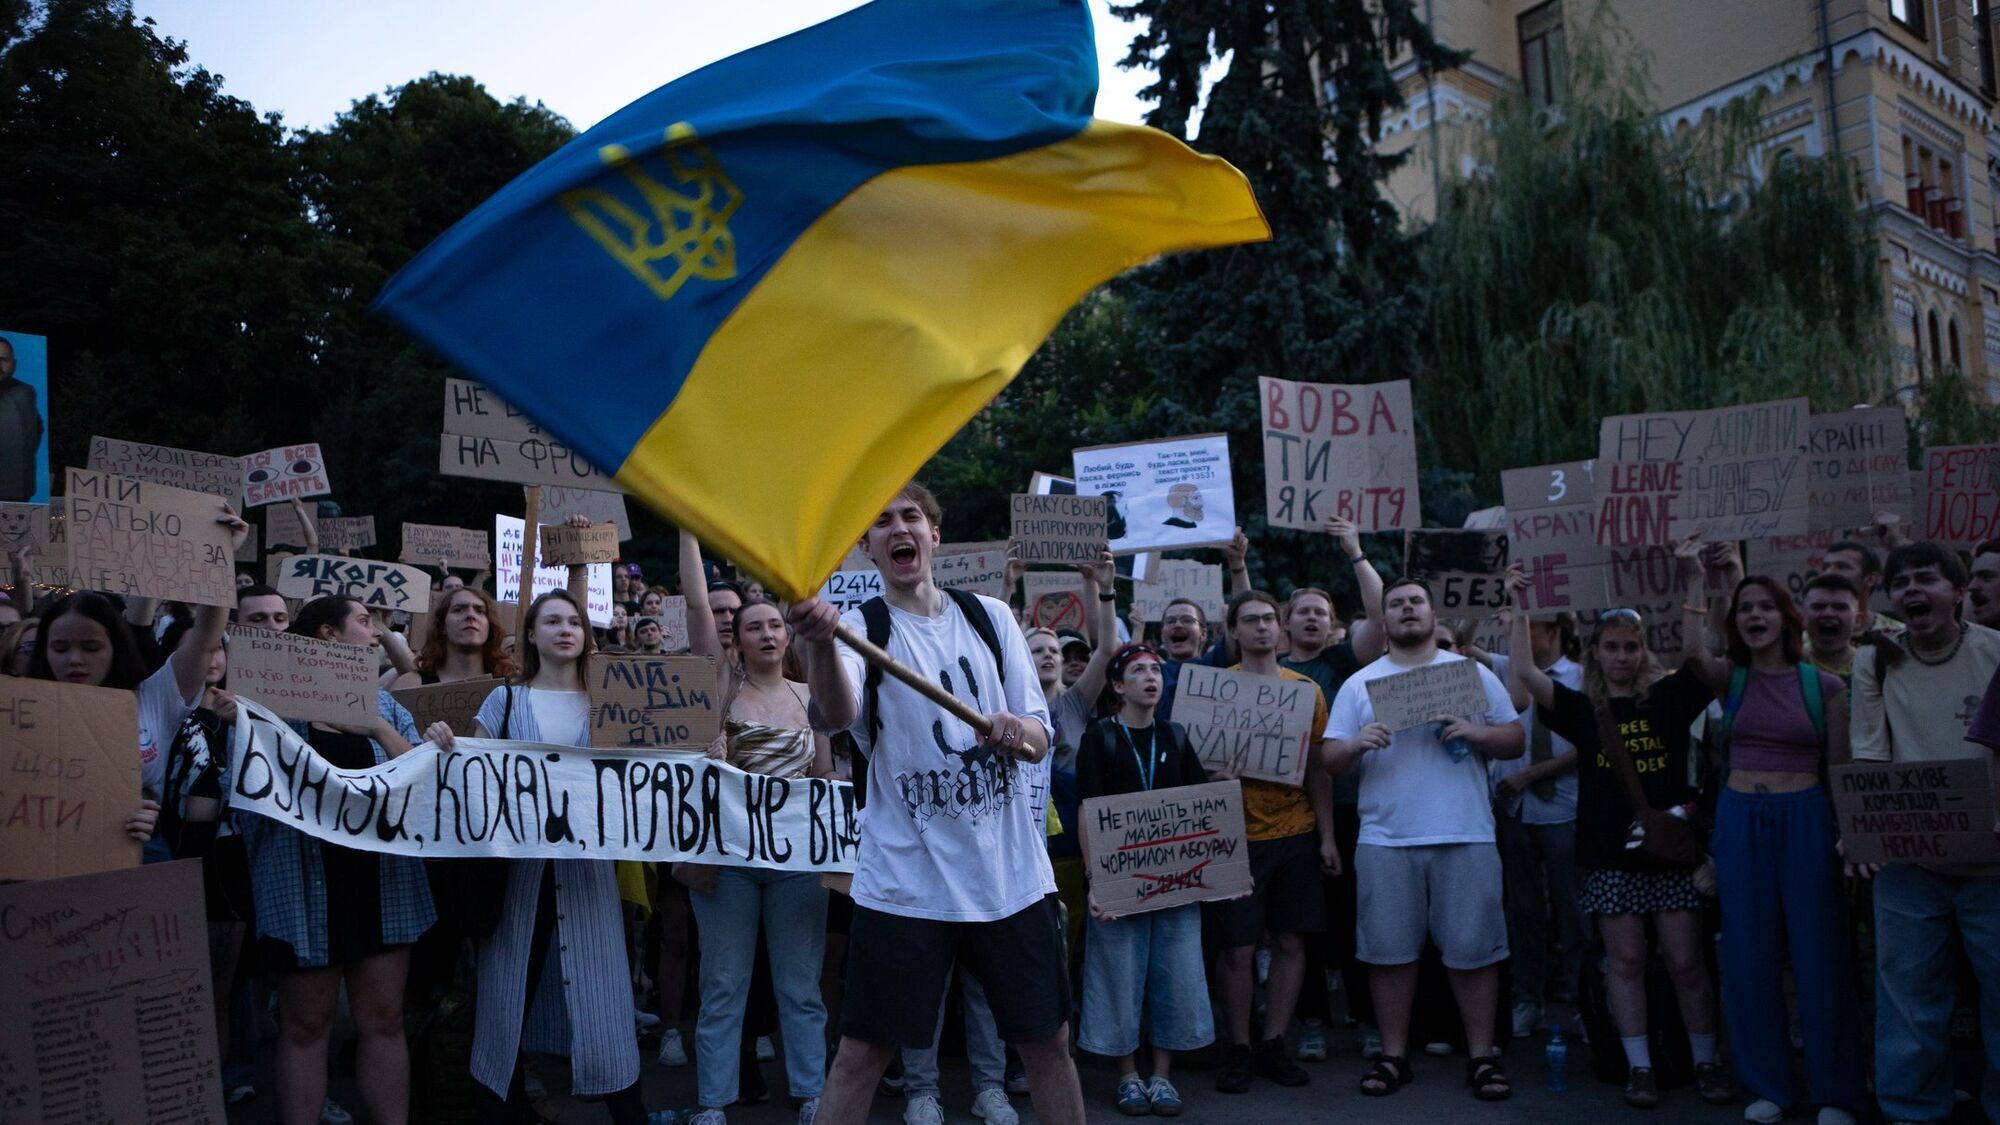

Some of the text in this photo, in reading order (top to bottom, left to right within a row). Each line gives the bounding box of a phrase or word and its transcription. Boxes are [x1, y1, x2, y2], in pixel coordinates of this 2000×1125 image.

[453, 384, 489, 415] НЕ
[95, 439, 108, 456] Я
[119, 443, 133, 462] З
[458, 435, 600, 478] НА ФРО
[1265, 429, 1332, 484] ТИ
[72, 471, 142, 505] МІЙ
[246, 475, 326, 503] БАЧАТЬ
[1611, 461, 1684, 494] LEAVE
[1688, 455, 1800, 520] НАБУ
[73, 497, 182, 537] БАТЬКО
[1013, 496, 1106, 518] СРАКУ СВОЮ
[1274, 484, 1406, 531] ЯК ВІТЯ
[1596, 493, 1680, 546] ALONE
[1014, 519, 1106, 537] ГЕНПРОКУРОРУ
[72, 523, 195, 561] ЗАГИНУВ
[202, 543, 228, 567] ЗА
[88, 567, 114, 593] НЕ
[118, 571, 142, 596] ЗА
[291, 557, 409, 589] ЯКОГО
[828, 574, 882, 595] 12414
[1147, 568, 1211, 588] АПТІ
[1515, 552, 1571, 611] НЕ
[233, 666, 254, 680] ТО
[415, 691, 483, 717] СВОБО
[1186, 668, 1299, 712] ЩО ВИ
[1211, 704, 1285, 734] БЛЯХА
[1617, 719, 1651, 736] REE
[11, 751, 89, 782] ЩОБ
[1841, 765, 1952, 793] ПОКИ ЖИВЕ
[236, 708, 424, 850] БУНТУЙ,
[436, 752, 587, 851] КОХАЙ,
[591, 757, 729, 857] ПРАВА
[808, 777, 861, 866] ВІД
[1861, 791, 1941, 812] КОРУПЦІЯ
[0, 793, 88, 833] АТИ
[1125, 799, 1188, 826] ПИШІТЬ
[1192, 798, 1228, 814] НАМ
[1851, 811, 1970, 834] МАЙБУТНЬОГО
[1123, 815, 1214, 846] МАЙБУТНЄ
[1879, 833, 1949, 858] НЕМАЄ
[1099, 838, 1238, 876] ЧОРНИЛОМ АБСУРДУ
